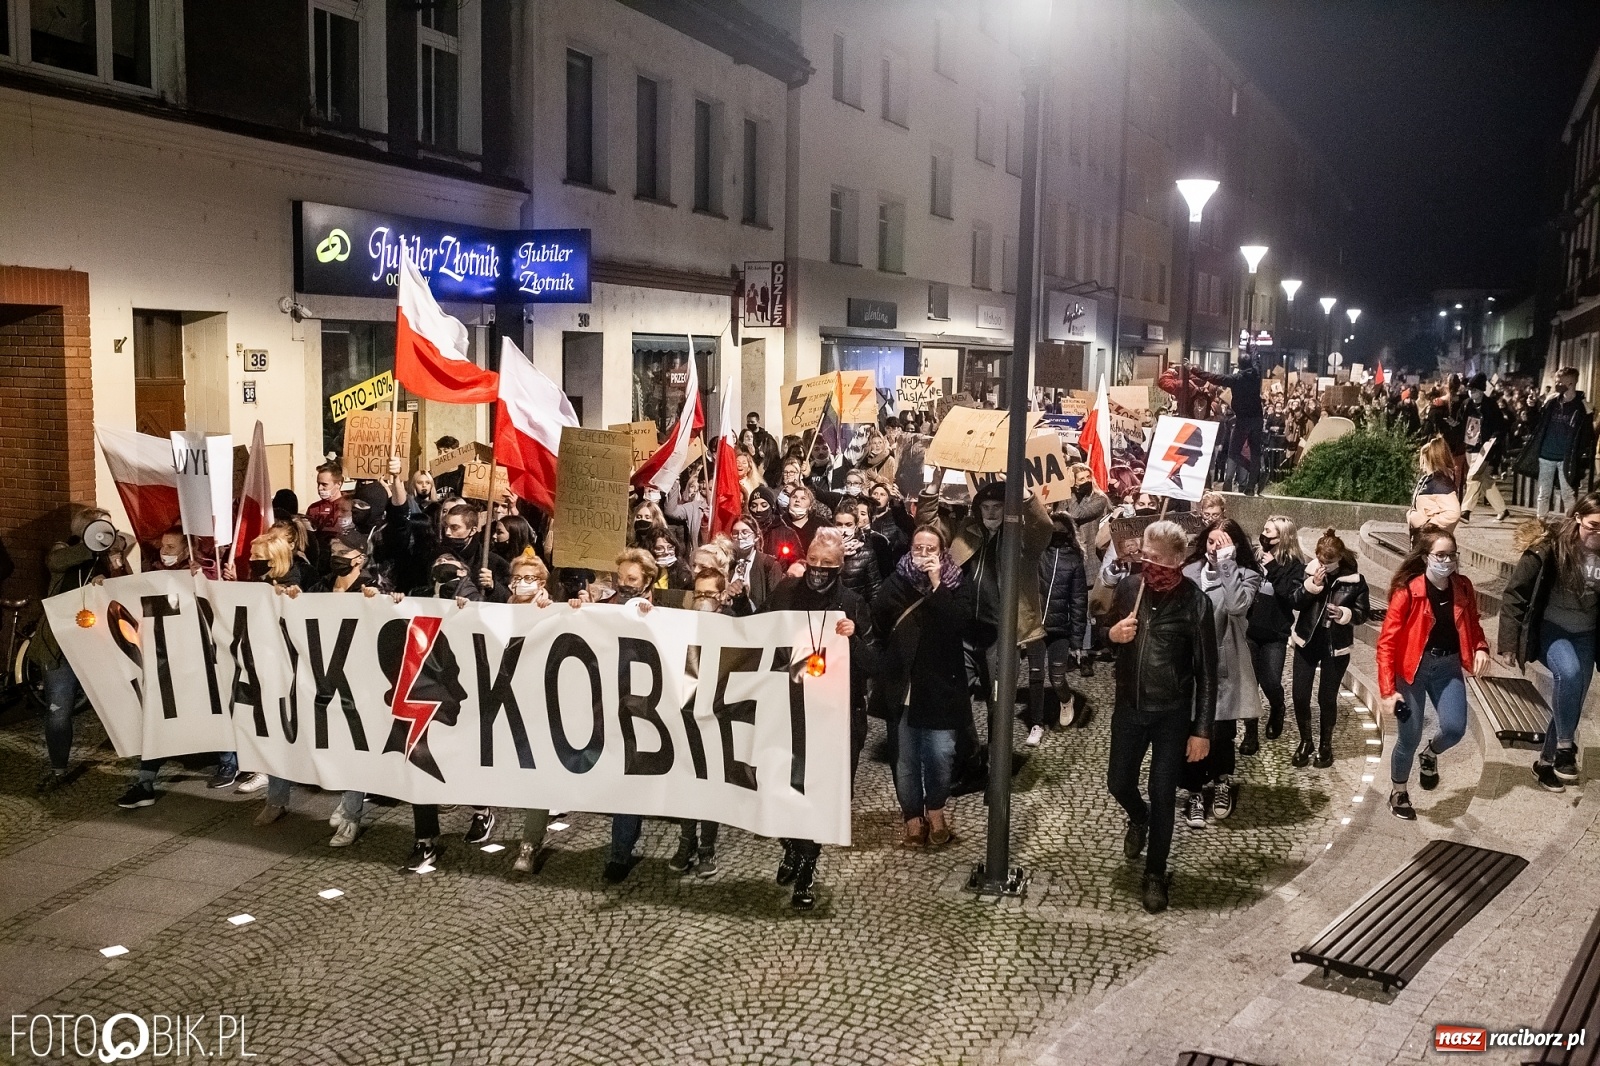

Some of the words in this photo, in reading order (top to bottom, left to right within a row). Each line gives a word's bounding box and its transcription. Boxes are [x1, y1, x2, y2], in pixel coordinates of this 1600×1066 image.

[369, 226, 437, 281] Jubiler
[439, 235, 500, 282] Złotnik
[518, 242, 573, 269] Jubiler
[519, 271, 575, 294] Złotnik
[251, 353, 267, 367] 36
[901, 378, 925, 390] MOJA
[332, 387, 367, 418] ZŁOTO
[368, 375, 393, 399] -10%
[896, 388, 927, 402] PUSIA
[350, 416, 380, 429] GIRLS
[348, 429, 380, 442] WANNA
[384, 430, 408, 444] HVE
[578, 431, 618, 445] CHCEMY
[347, 442, 408, 458] FUNDAMENAL
[559, 442, 590, 457] DZIECI
[601, 447, 612, 460] Z
[355, 457, 402, 475] RIGH
[608, 482, 624, 495] NIE
[563, 508, 622, 532] TERRORU
[472, 632, 826, 795] KOBIET
